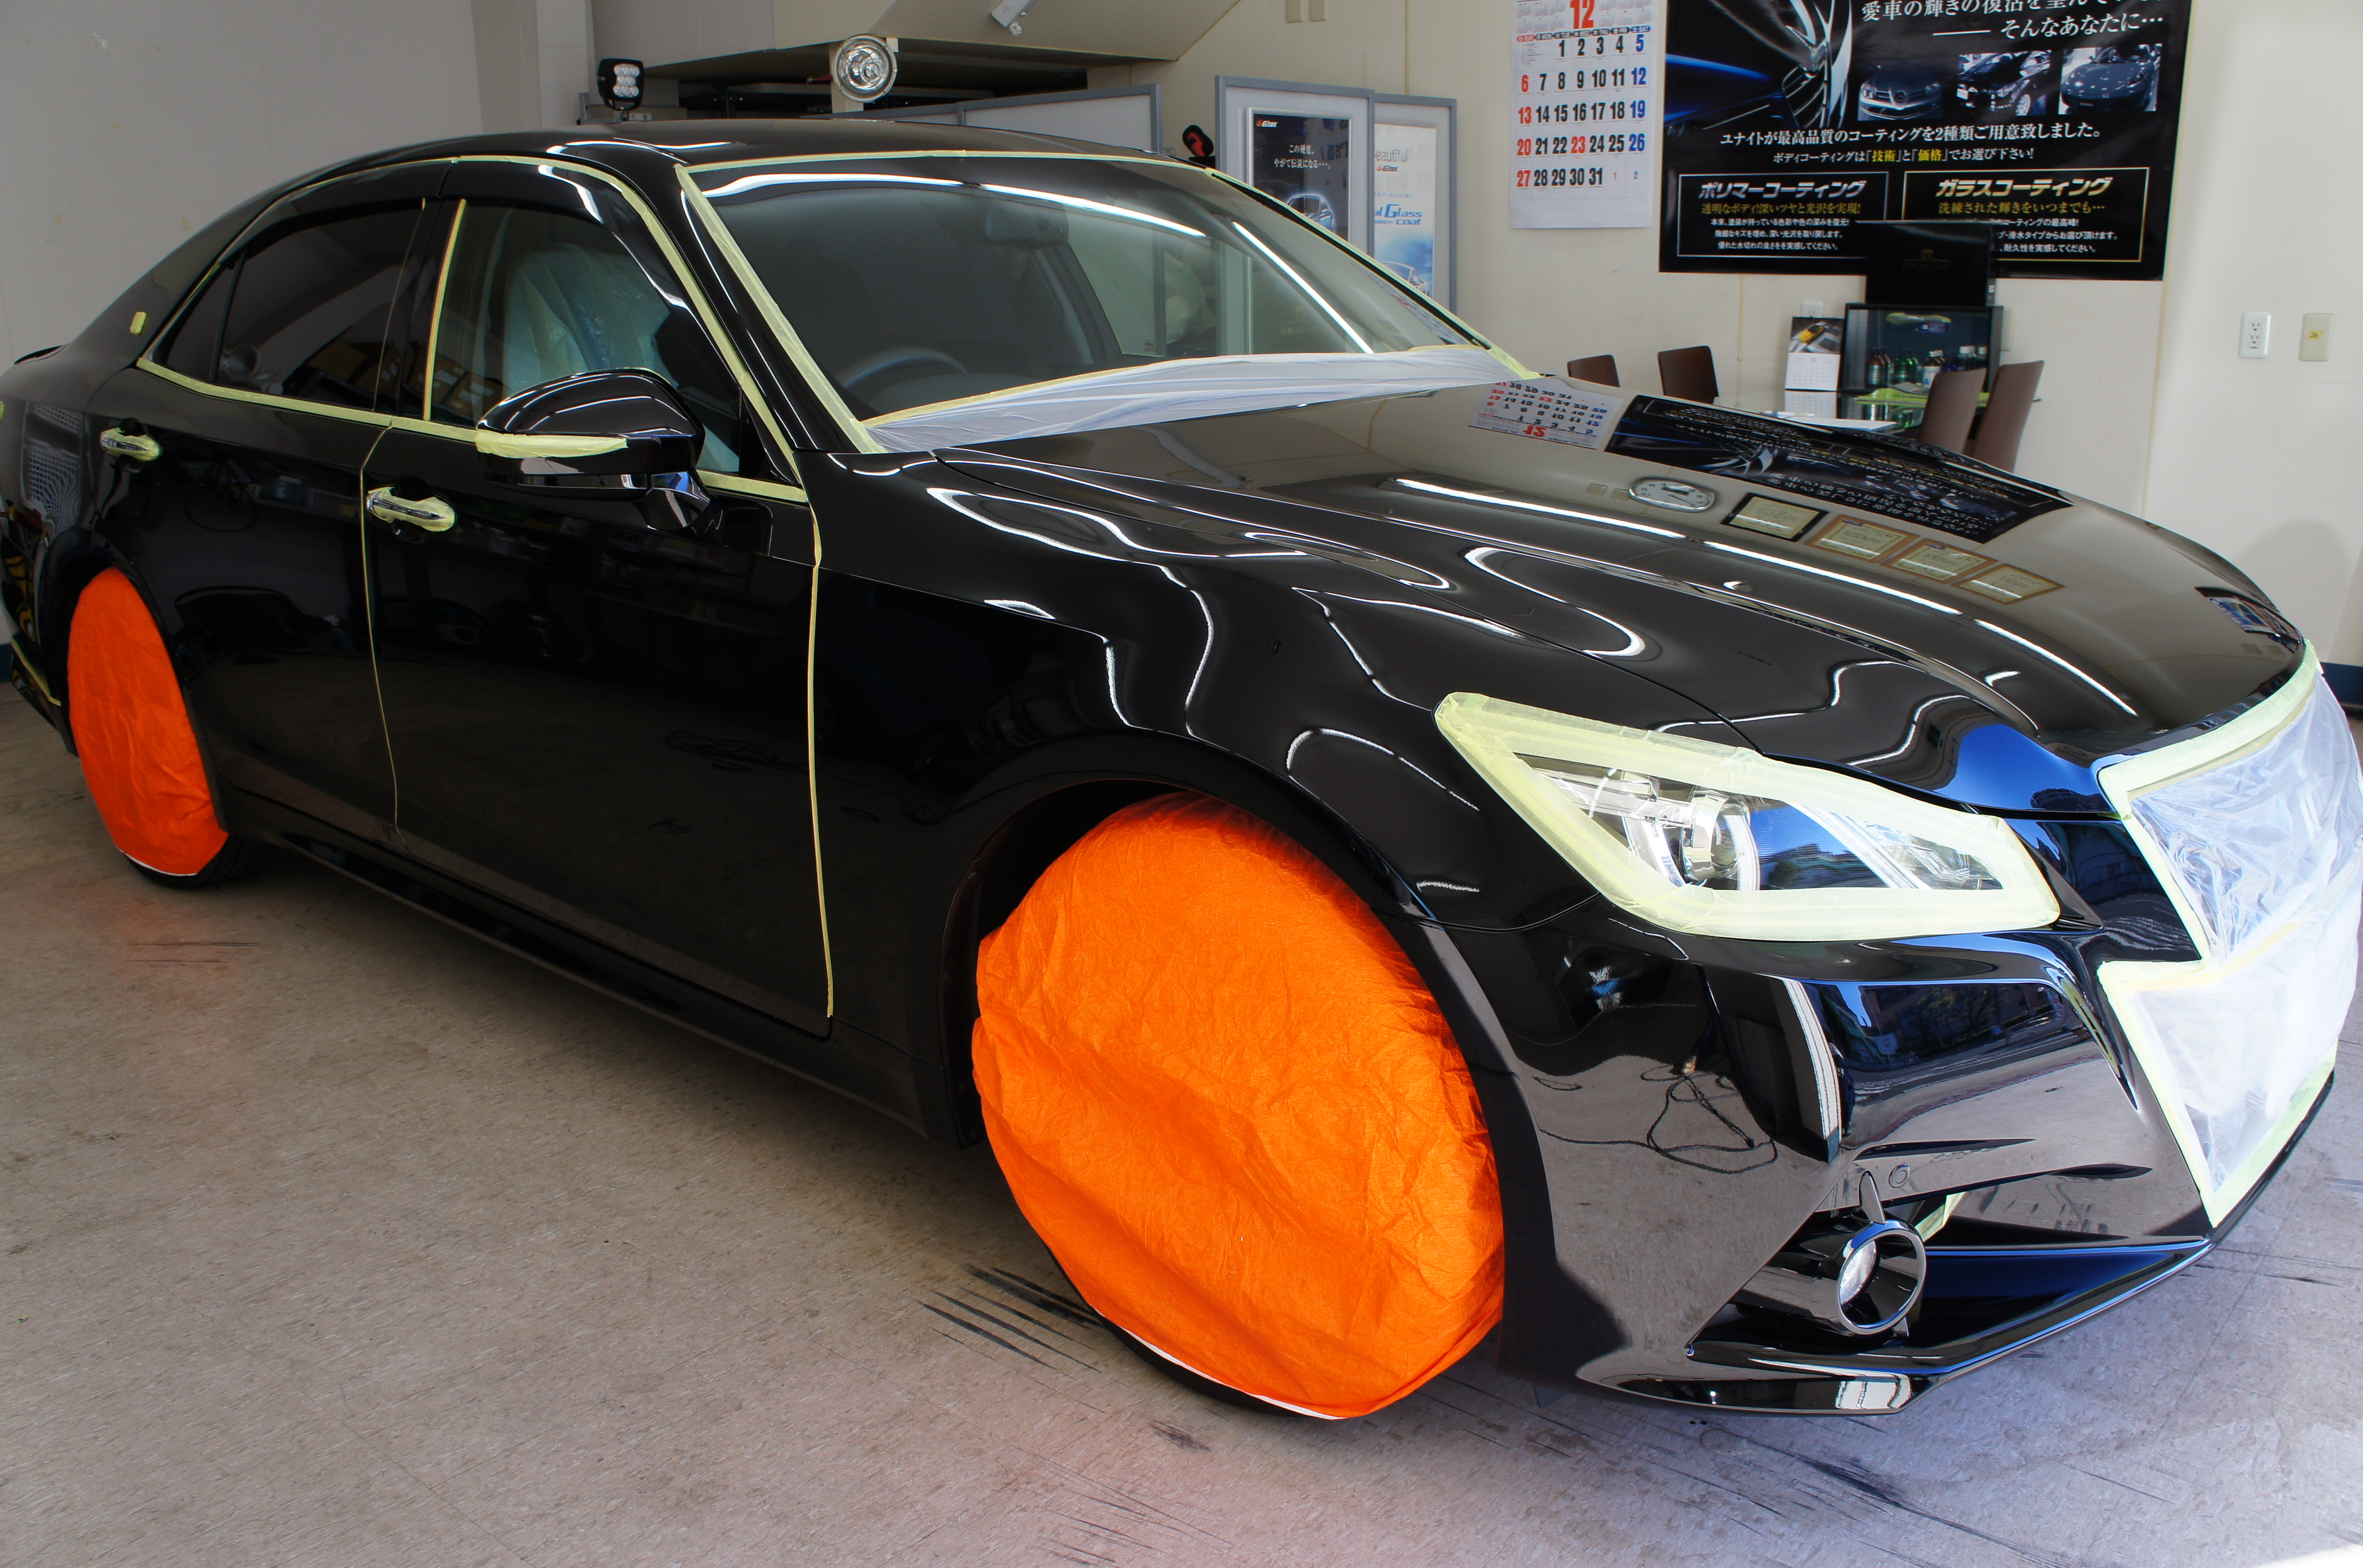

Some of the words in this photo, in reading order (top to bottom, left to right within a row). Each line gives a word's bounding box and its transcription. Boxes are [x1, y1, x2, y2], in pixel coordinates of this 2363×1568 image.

[1570, 0, 1595, 29] 12
[1559, 38, 1565, 57] 1
[1578, 37, 1585, 56] 2
[1597, 36, 1603, 55] 3
[1616, 35, 1623, 53] 4
[1636, 34, 1644, 52] 5
[1522, 75, 1528, 92] 6
[1540, 74, 1547, 91] 7
[1558, 72, 1565, 90] 8
[1578, 71, 1584, 89] 9
[1592, 69, 1606, 87] 10
[1612, 68, 1625, 86] 11
[1632, 67, 1646, 85] 12
[1519, 107, 1531, 124] 13
[1536, 105, 1550, 123] 14
[1554, 105, 1568, 122] 15
[1573, 103, 1586, 121] 16
[1591, 102, 1605, 120] 17
[1610, 101, 1625, 119] 18
[1631, 100, 1645, 118] 19
[1517, 138, 1531, 156] 20
[1535, 138, 1548, 155] 21
[1552, 136, 1567, 154] 22
[1571, 136, 1585, 154] 23
[1589, 135, 1604, 153] 24
[1609, 134, 1625, 152] 25
[1629, 133, 1645, 151] 26
[1517, 170, 1531, 187] 27
[1534, 169, 1548, 187] 28
[1552, 168, 1566, 186] 29
[1570, 168, 1584, 186] 30
[1589, 168, 1602, 185] 31
[1935, 177, 2113, 197] ガラスコーティング
[1699, 180, 1867, 199] ポリマーコーティング
[1384, 203, 1423, 218] Glass
